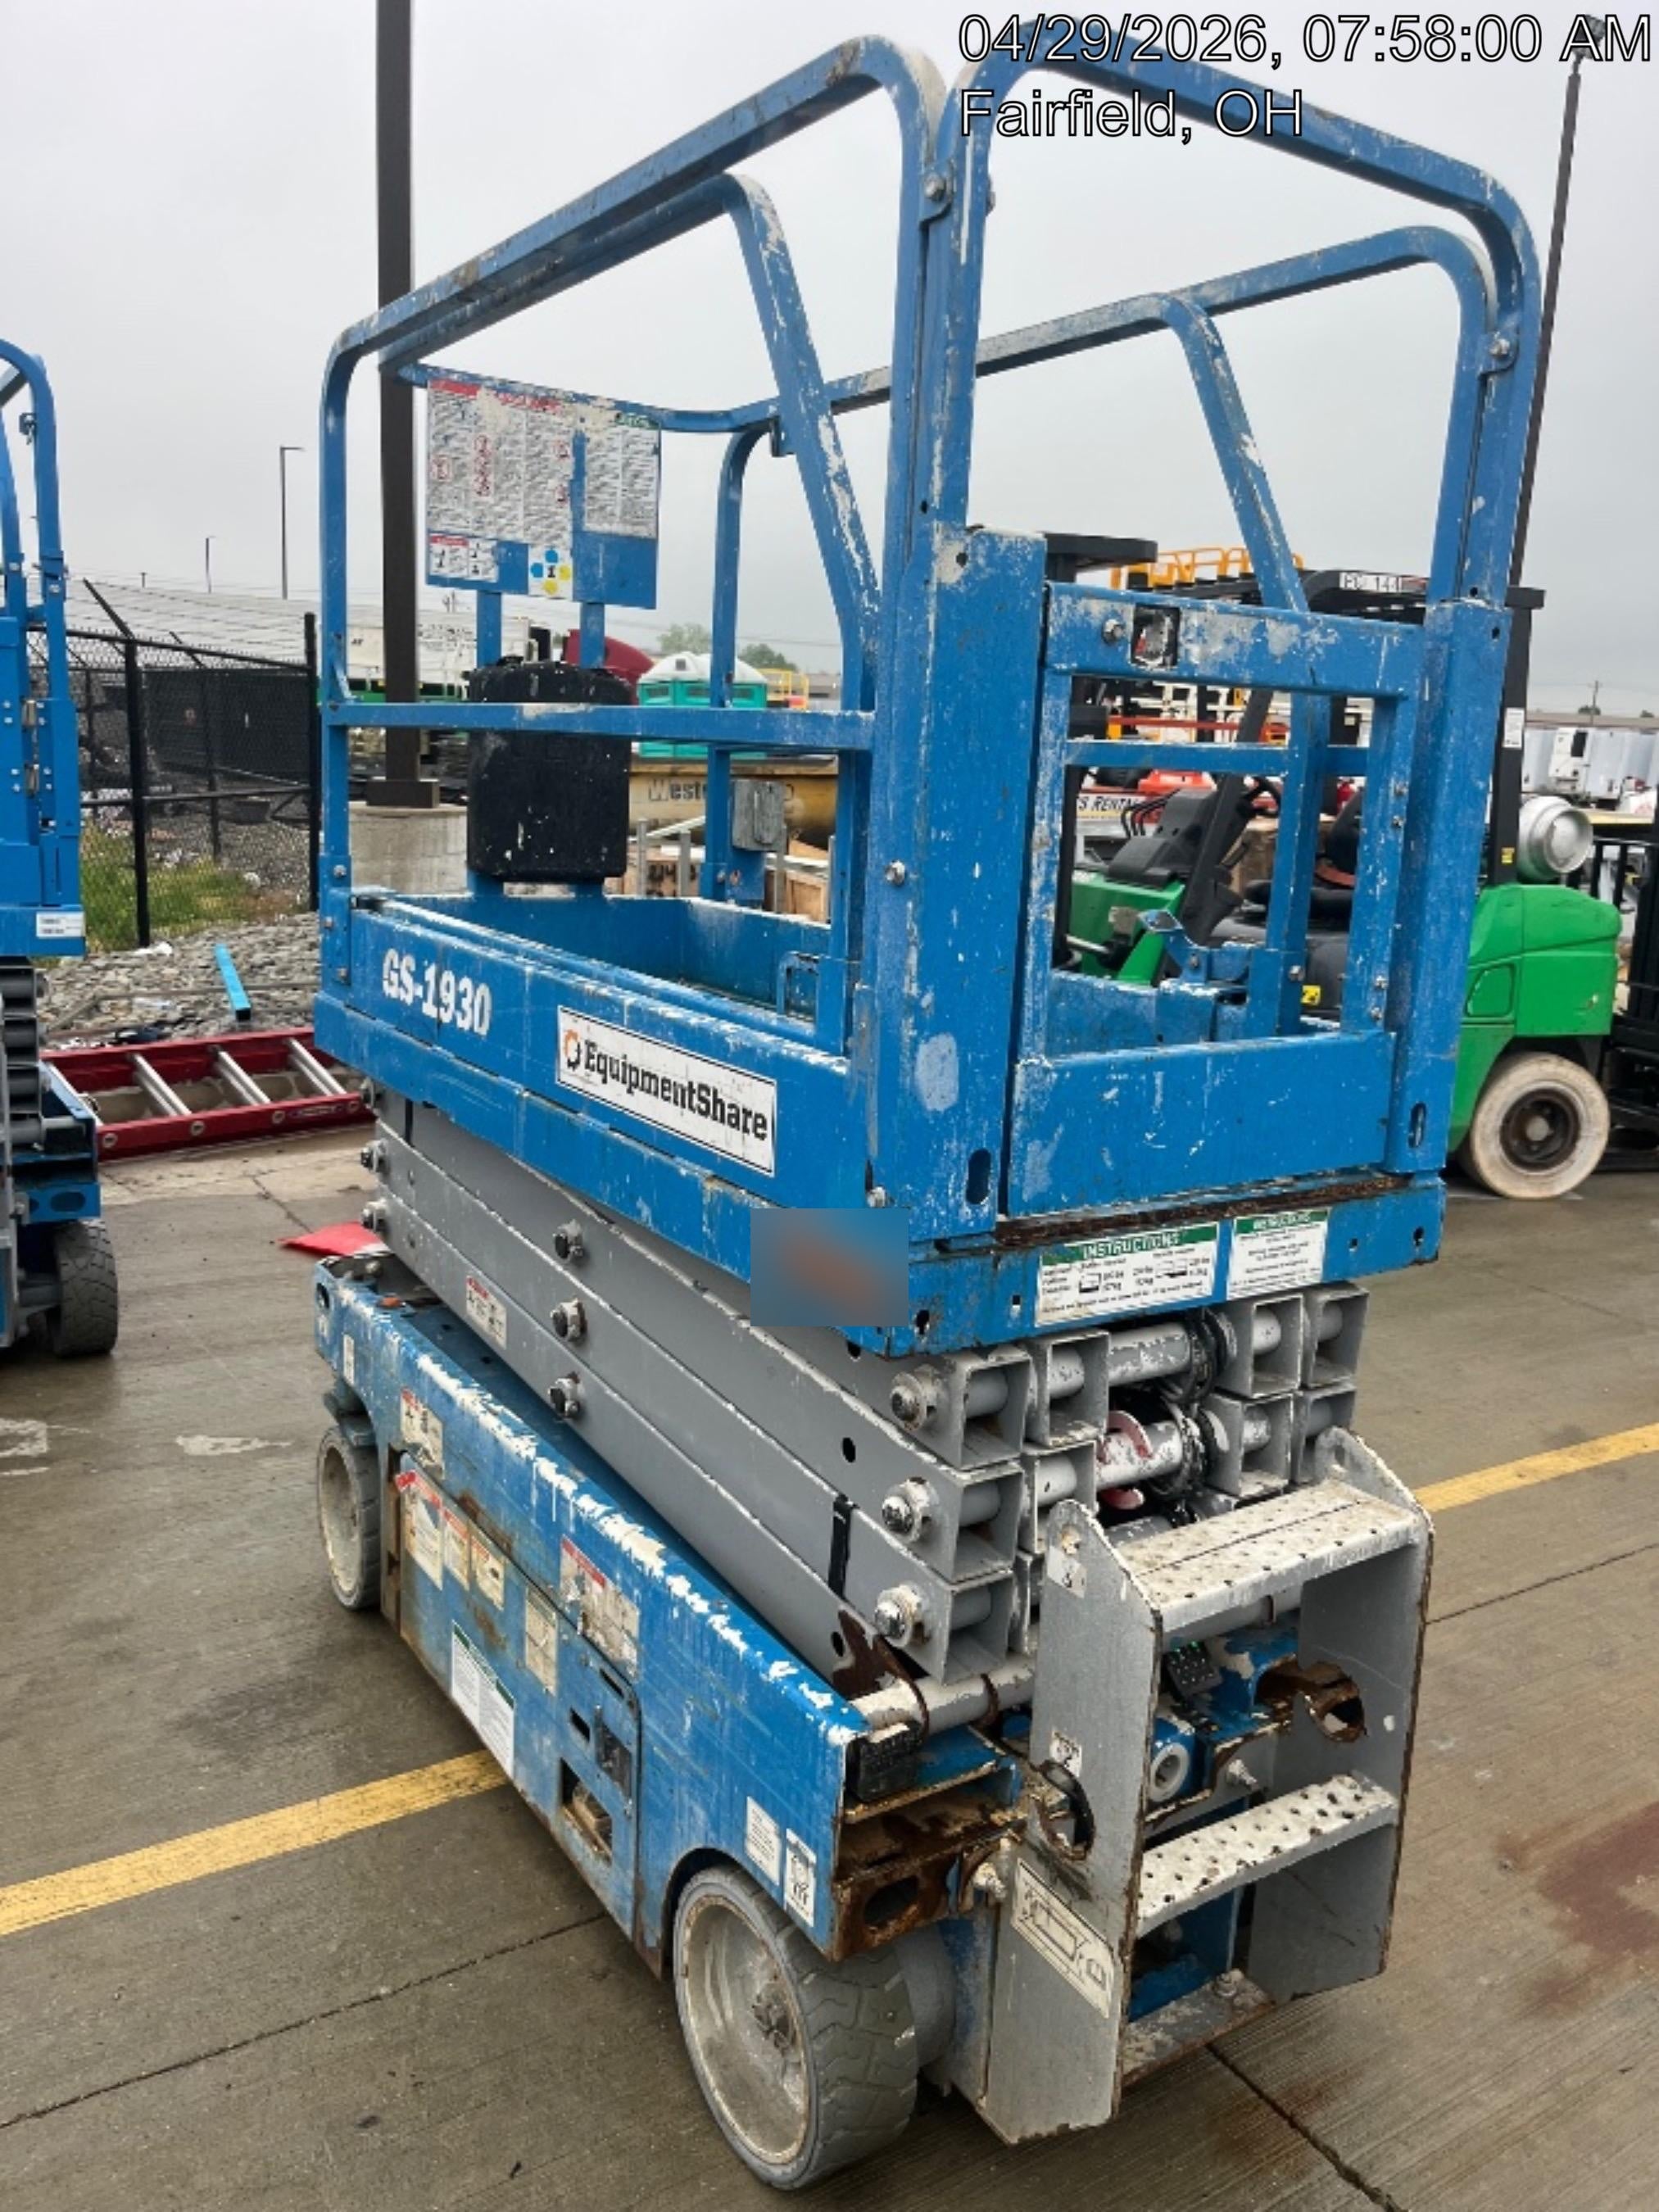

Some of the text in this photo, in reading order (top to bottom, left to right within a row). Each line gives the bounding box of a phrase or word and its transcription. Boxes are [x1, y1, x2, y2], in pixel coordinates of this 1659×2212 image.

[1092, 796, 1135, 811] RENTA
[382, 948, 492, 1036] GS-1930
[584, 1039, 768, 1141] EquipmentShare
[1082, 1231, 1181, 1259] INSTRUCTIONS
